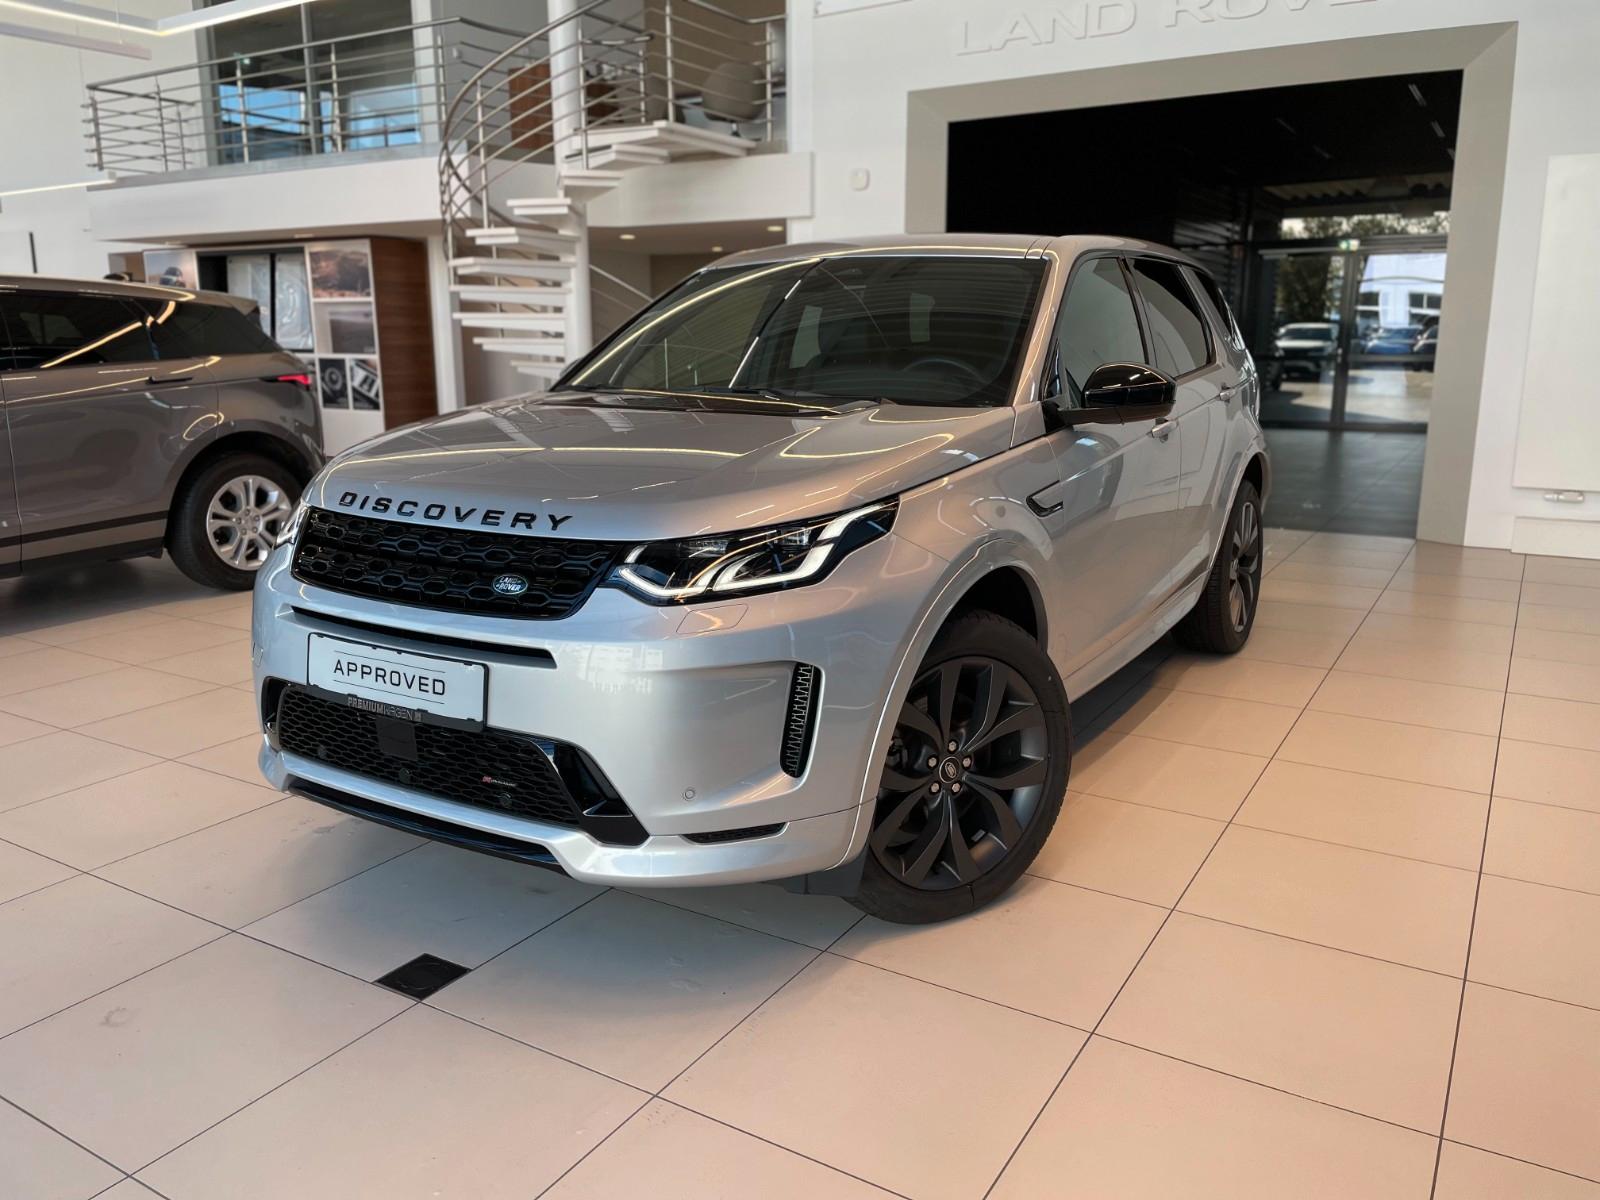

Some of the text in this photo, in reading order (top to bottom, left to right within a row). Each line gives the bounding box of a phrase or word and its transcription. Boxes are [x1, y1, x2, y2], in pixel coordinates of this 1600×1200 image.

[956, 0, 1137, 56] LAND
[338, 491, 573, 531] DISCOVERY
[333, 659, 446, 696] APPROVED
